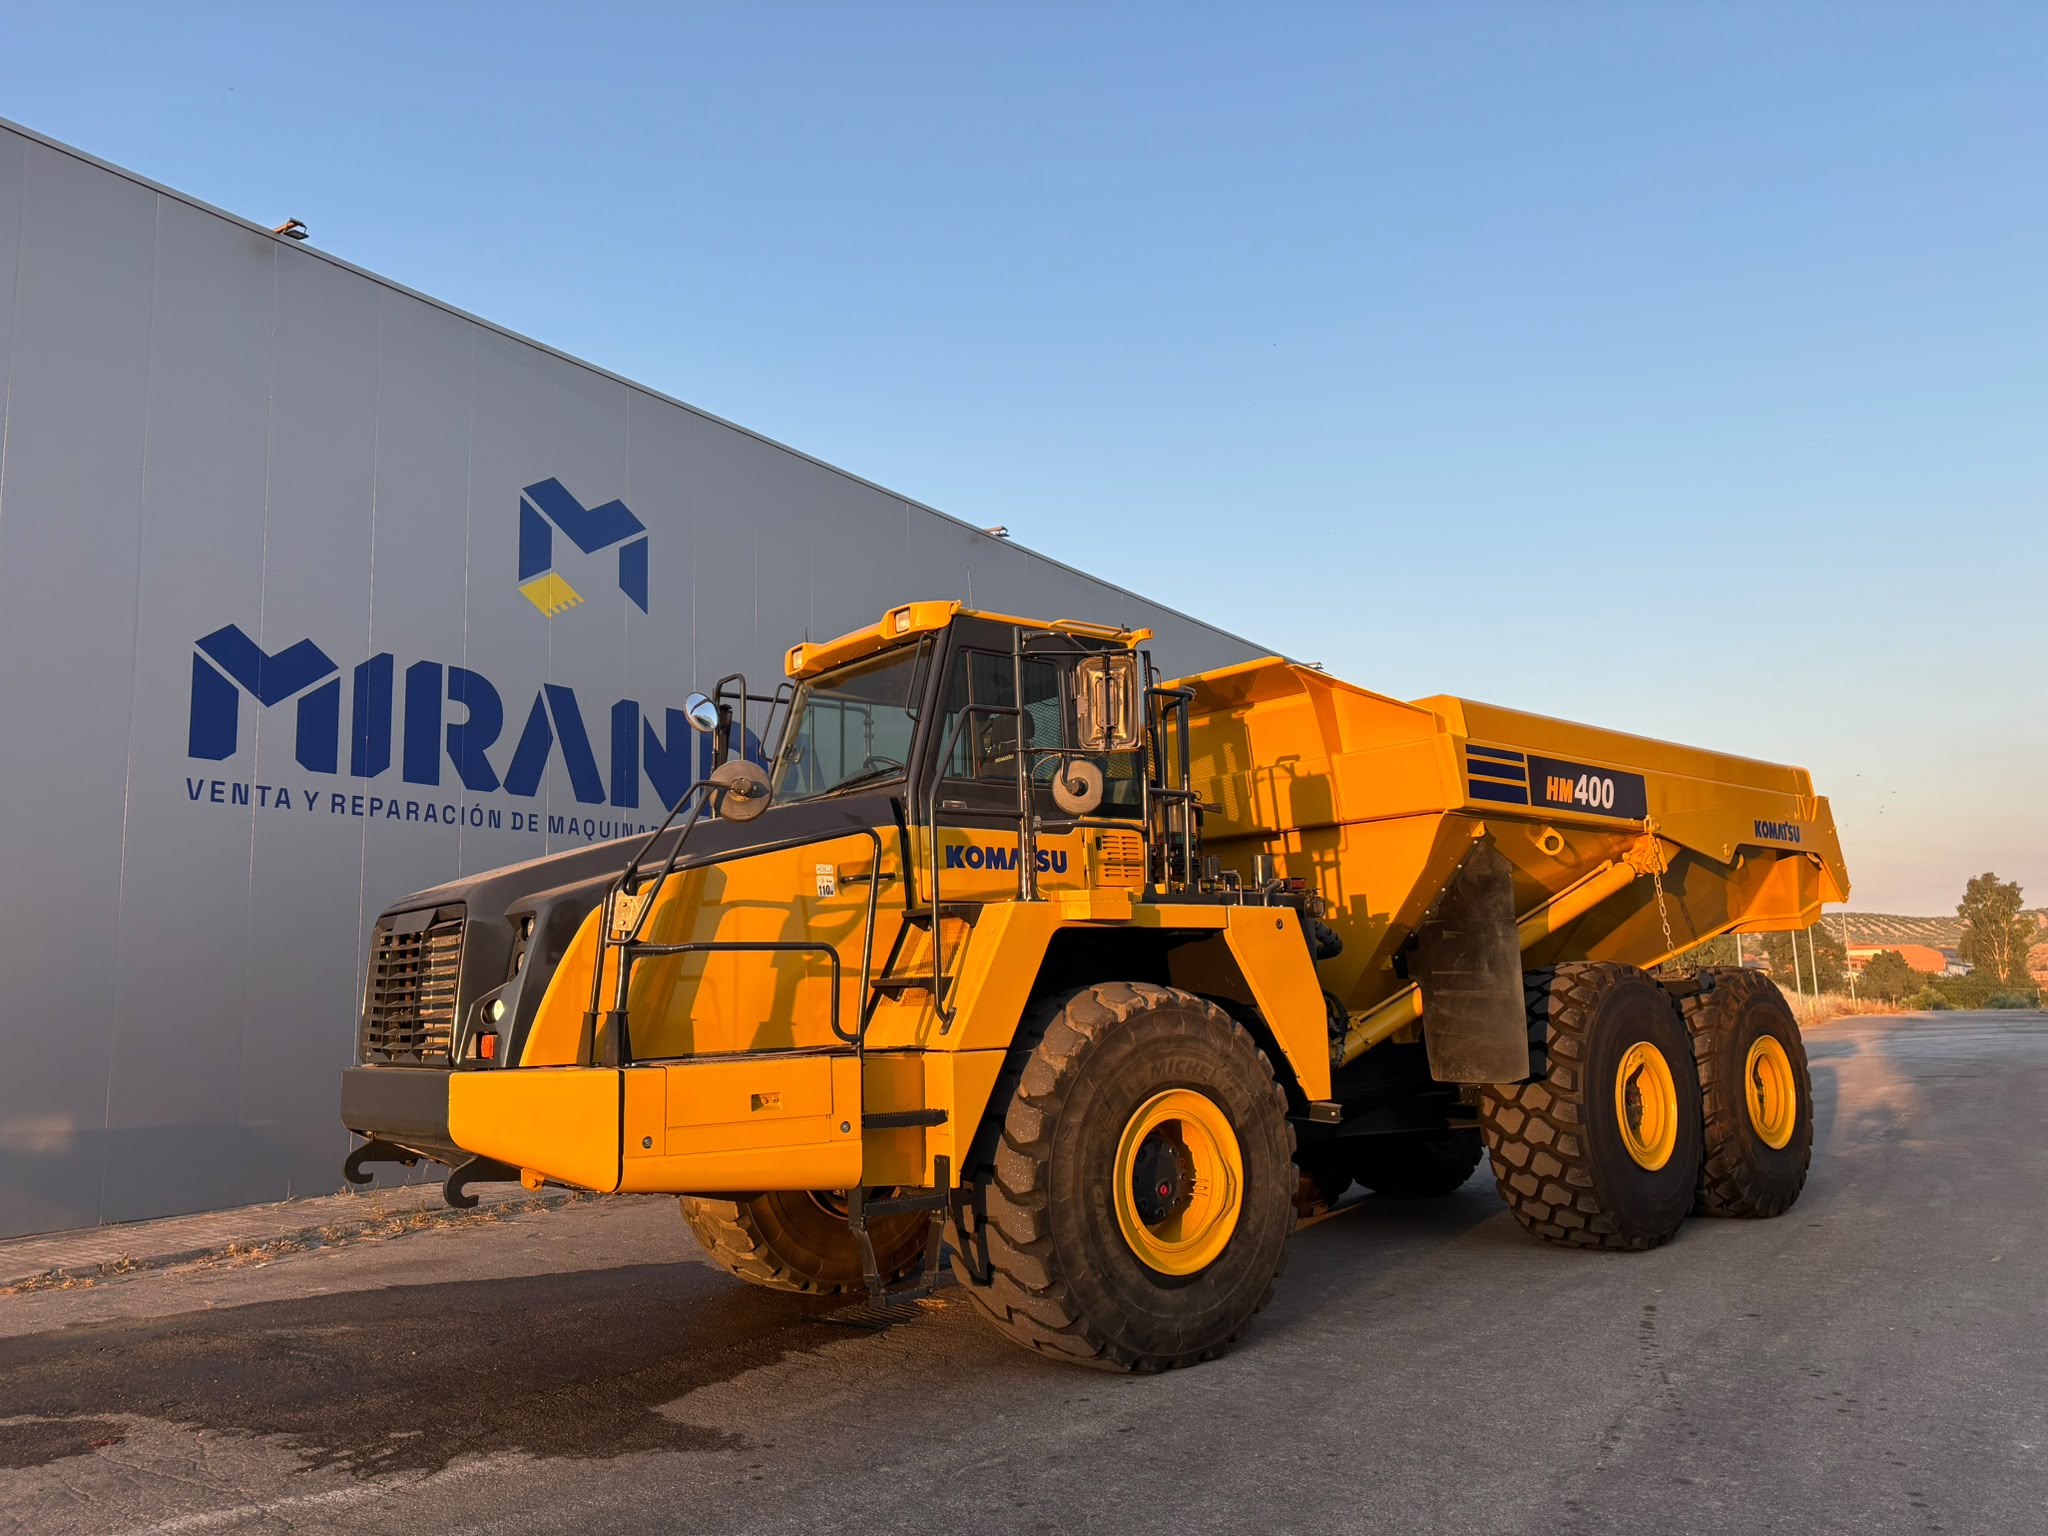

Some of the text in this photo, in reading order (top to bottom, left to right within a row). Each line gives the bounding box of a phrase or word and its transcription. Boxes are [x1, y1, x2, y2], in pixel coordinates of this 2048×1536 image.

[186, 778, 292, 810] VENTA
[304, 790, 319, 811] Y
[331, 793, 501, 829] REPARACIÓN
[511, 811, 538, 832] DE
[1546, 774, 1614, 809] HM400
[1754, 820, 1800, 843] KOMATSU
[945, 845, 1067, 873] KOMASU
